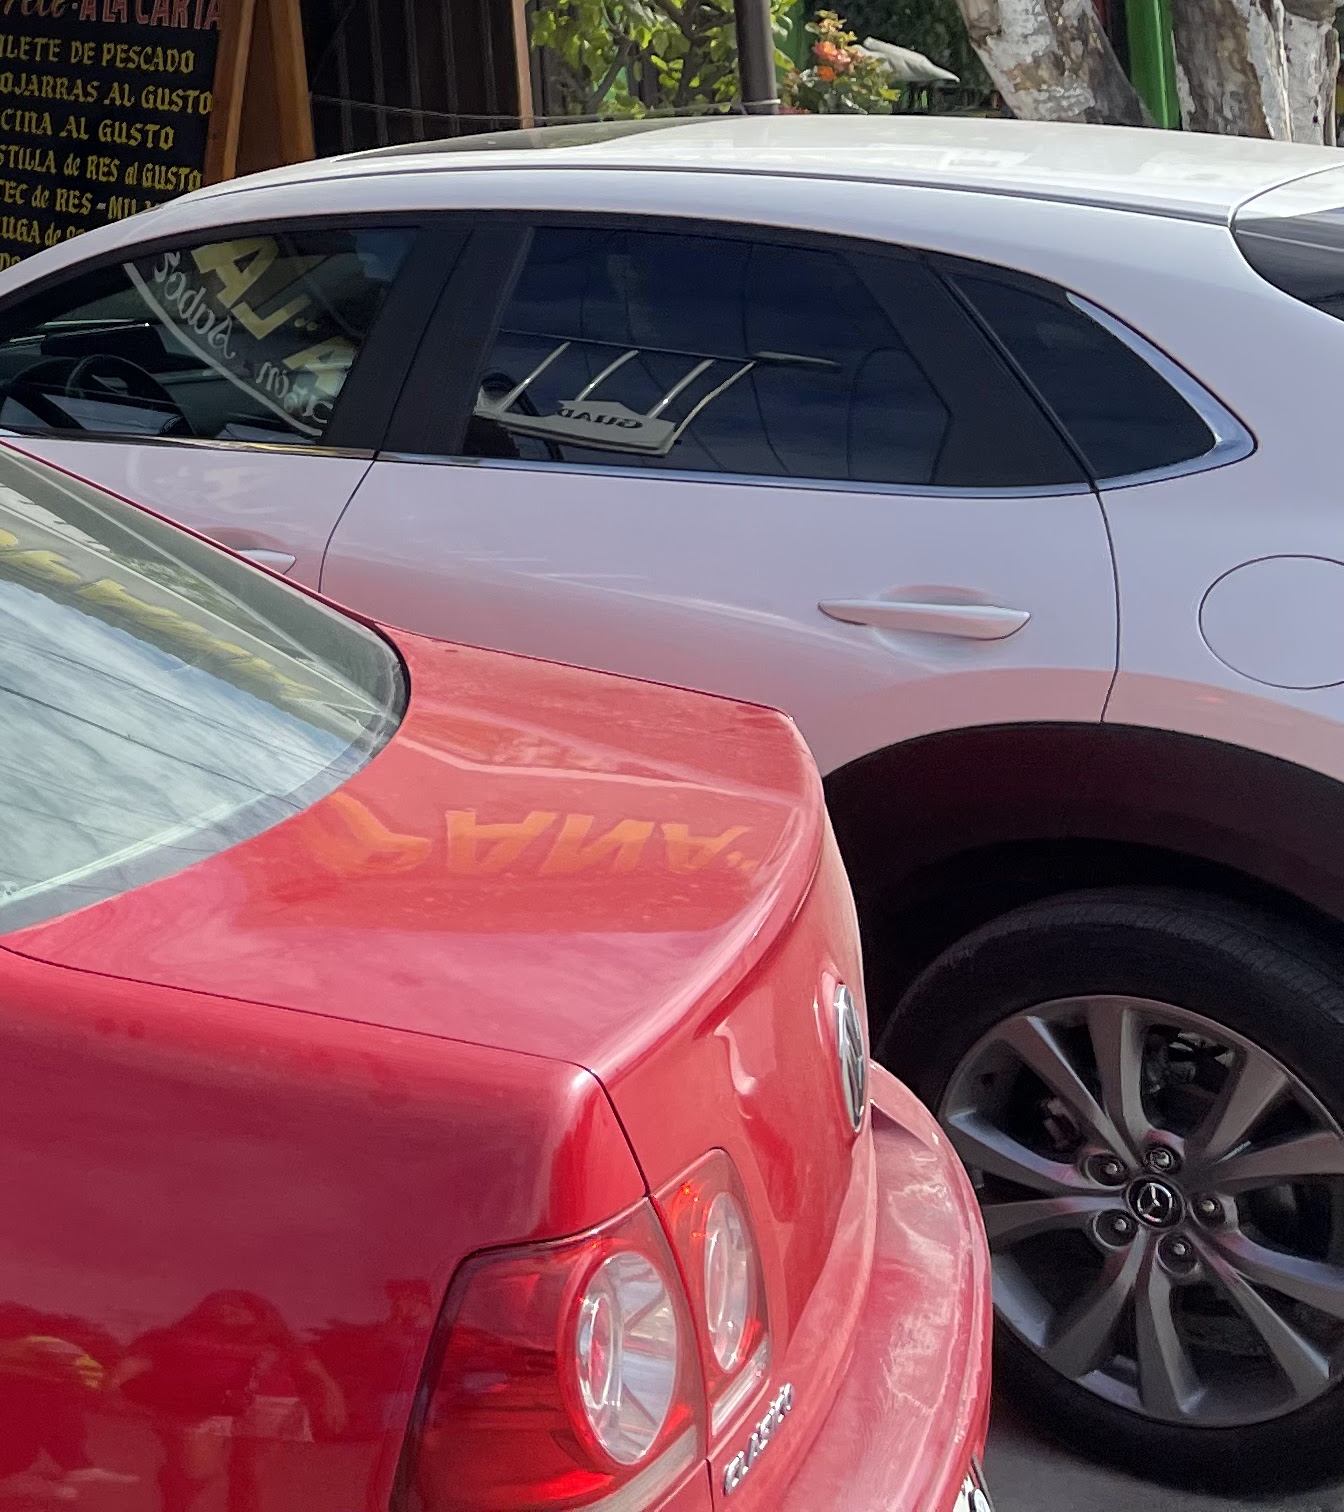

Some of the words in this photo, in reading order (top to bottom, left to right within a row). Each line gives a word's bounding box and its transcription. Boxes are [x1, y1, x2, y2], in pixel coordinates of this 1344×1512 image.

[70, 40, 96, 65] DE
[101, 43, 196, 74] PESCADO
[103, 82, 136, 108] AL
[141, 85, 212, 115] GUSTO
[59, 115, 89, 140] AL
[98, 119, 175, 150] GUSTO
[64, 153, 80, 176] de
[86, 155, 120, 182] RES
[142, 163, 202, 192] GUSTO
[31, 186, 50, 210] de
[55, 188, 92, 216] RES
